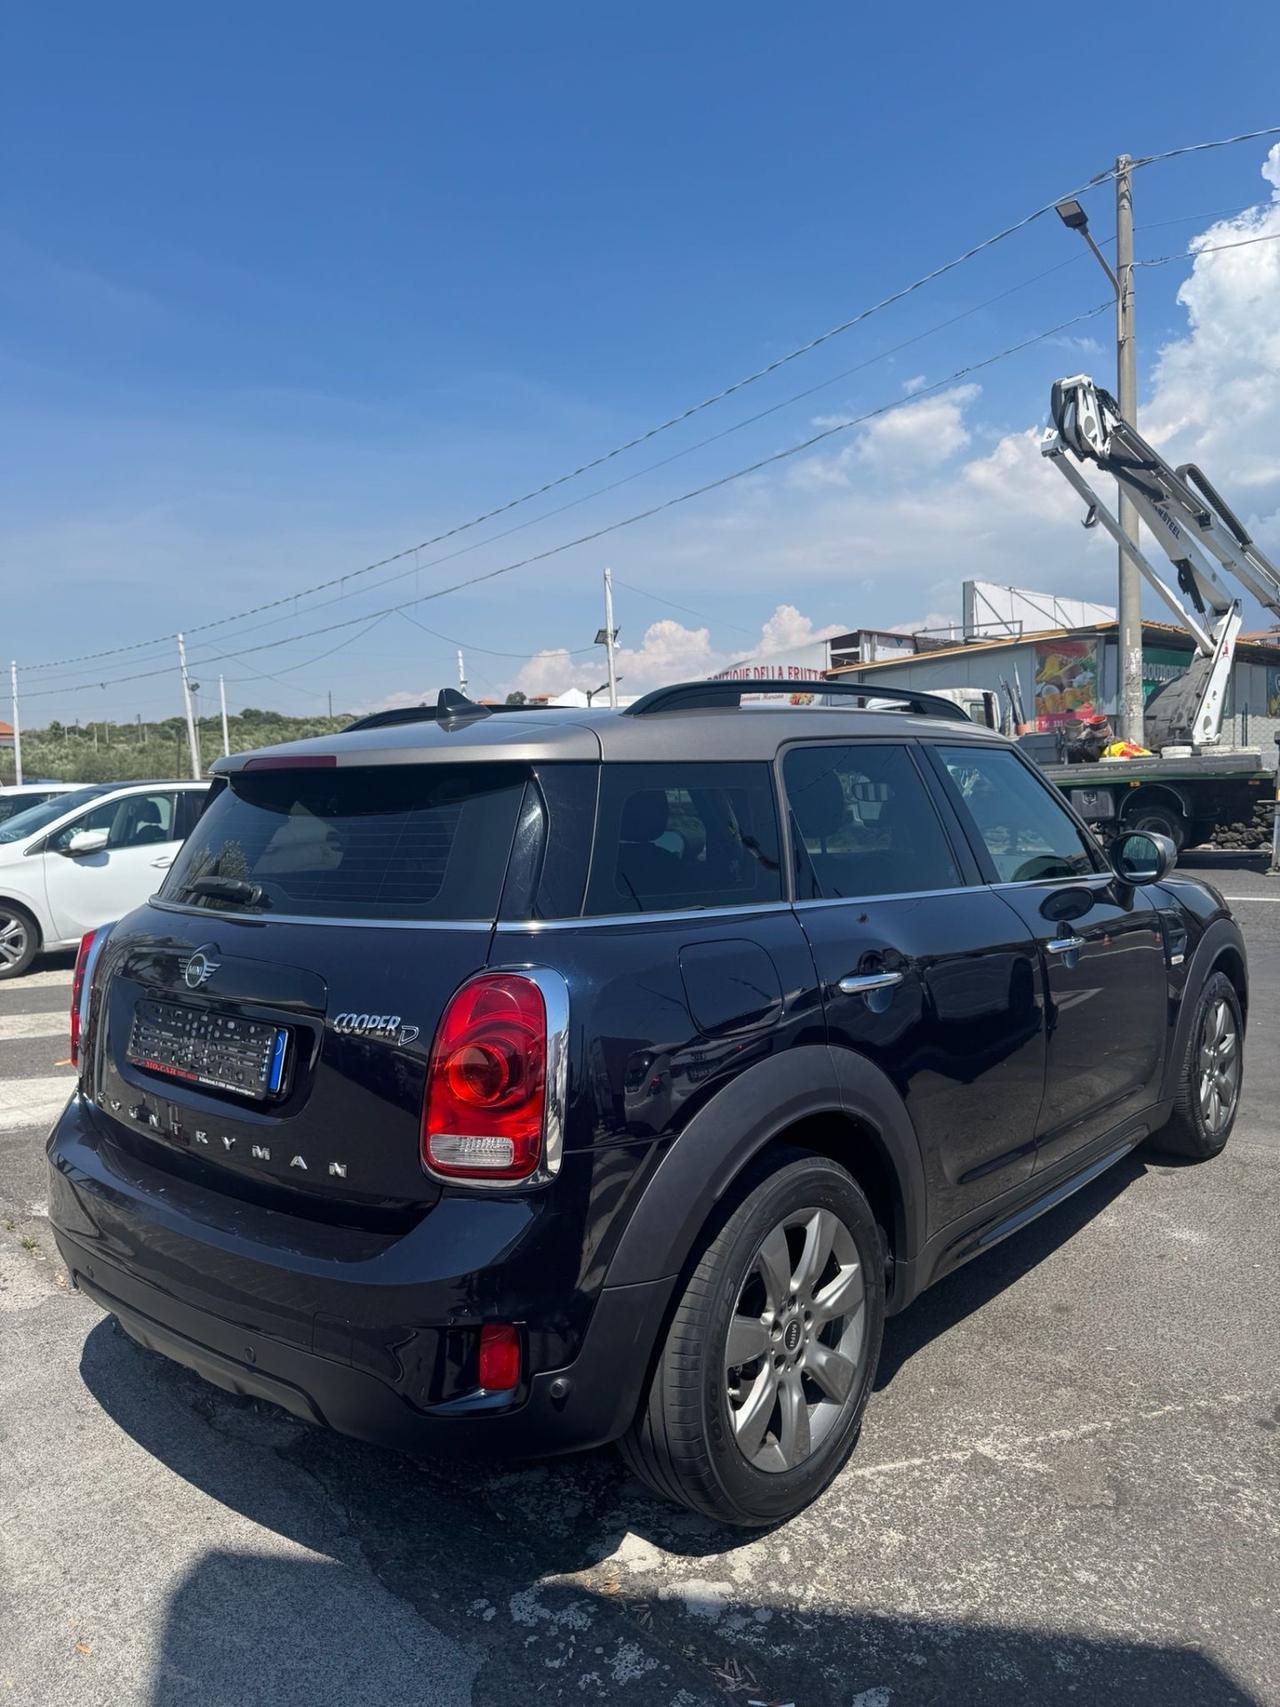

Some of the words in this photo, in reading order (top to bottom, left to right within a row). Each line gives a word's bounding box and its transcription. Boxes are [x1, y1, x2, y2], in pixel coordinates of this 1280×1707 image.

[754, 665, 784, 680] DELLA
[333, 1012, 401, 1037] COOPER
[398, 1025, 419, 1047] D
[97, 1090, 348, 1178] COUNTRYMAN
[789, 1323, 798, 1347] MINI
